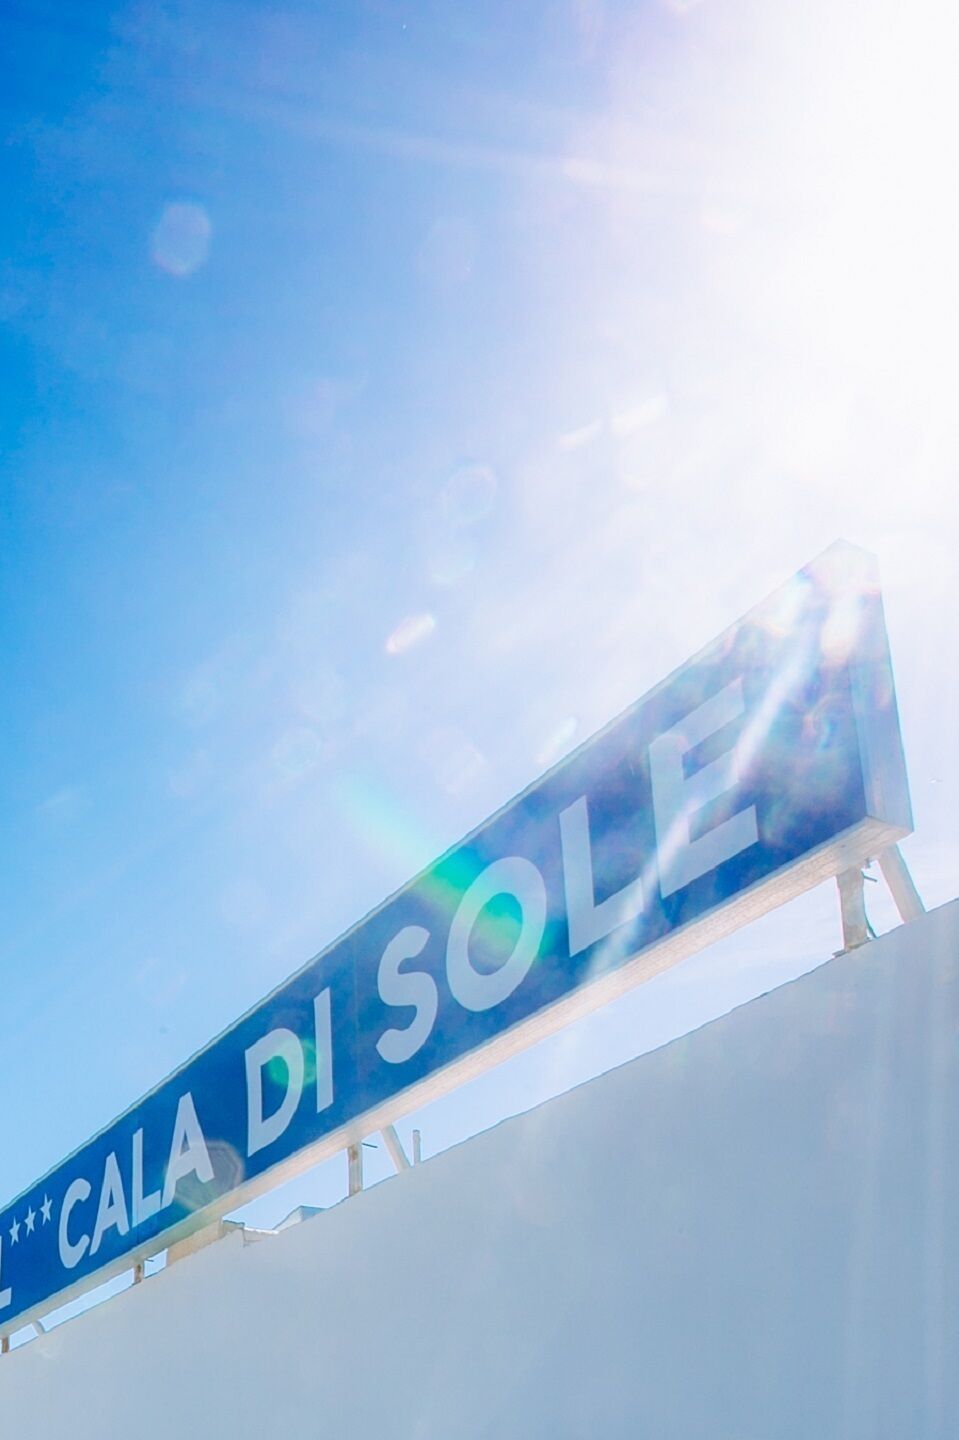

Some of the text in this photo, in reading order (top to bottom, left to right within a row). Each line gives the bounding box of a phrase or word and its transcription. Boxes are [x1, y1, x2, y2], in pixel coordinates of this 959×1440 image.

[57, 1091, 215, 1269] CALA
[244, 987, 334, 1158] DI
[375, 677, 759, 1064] SOLE
